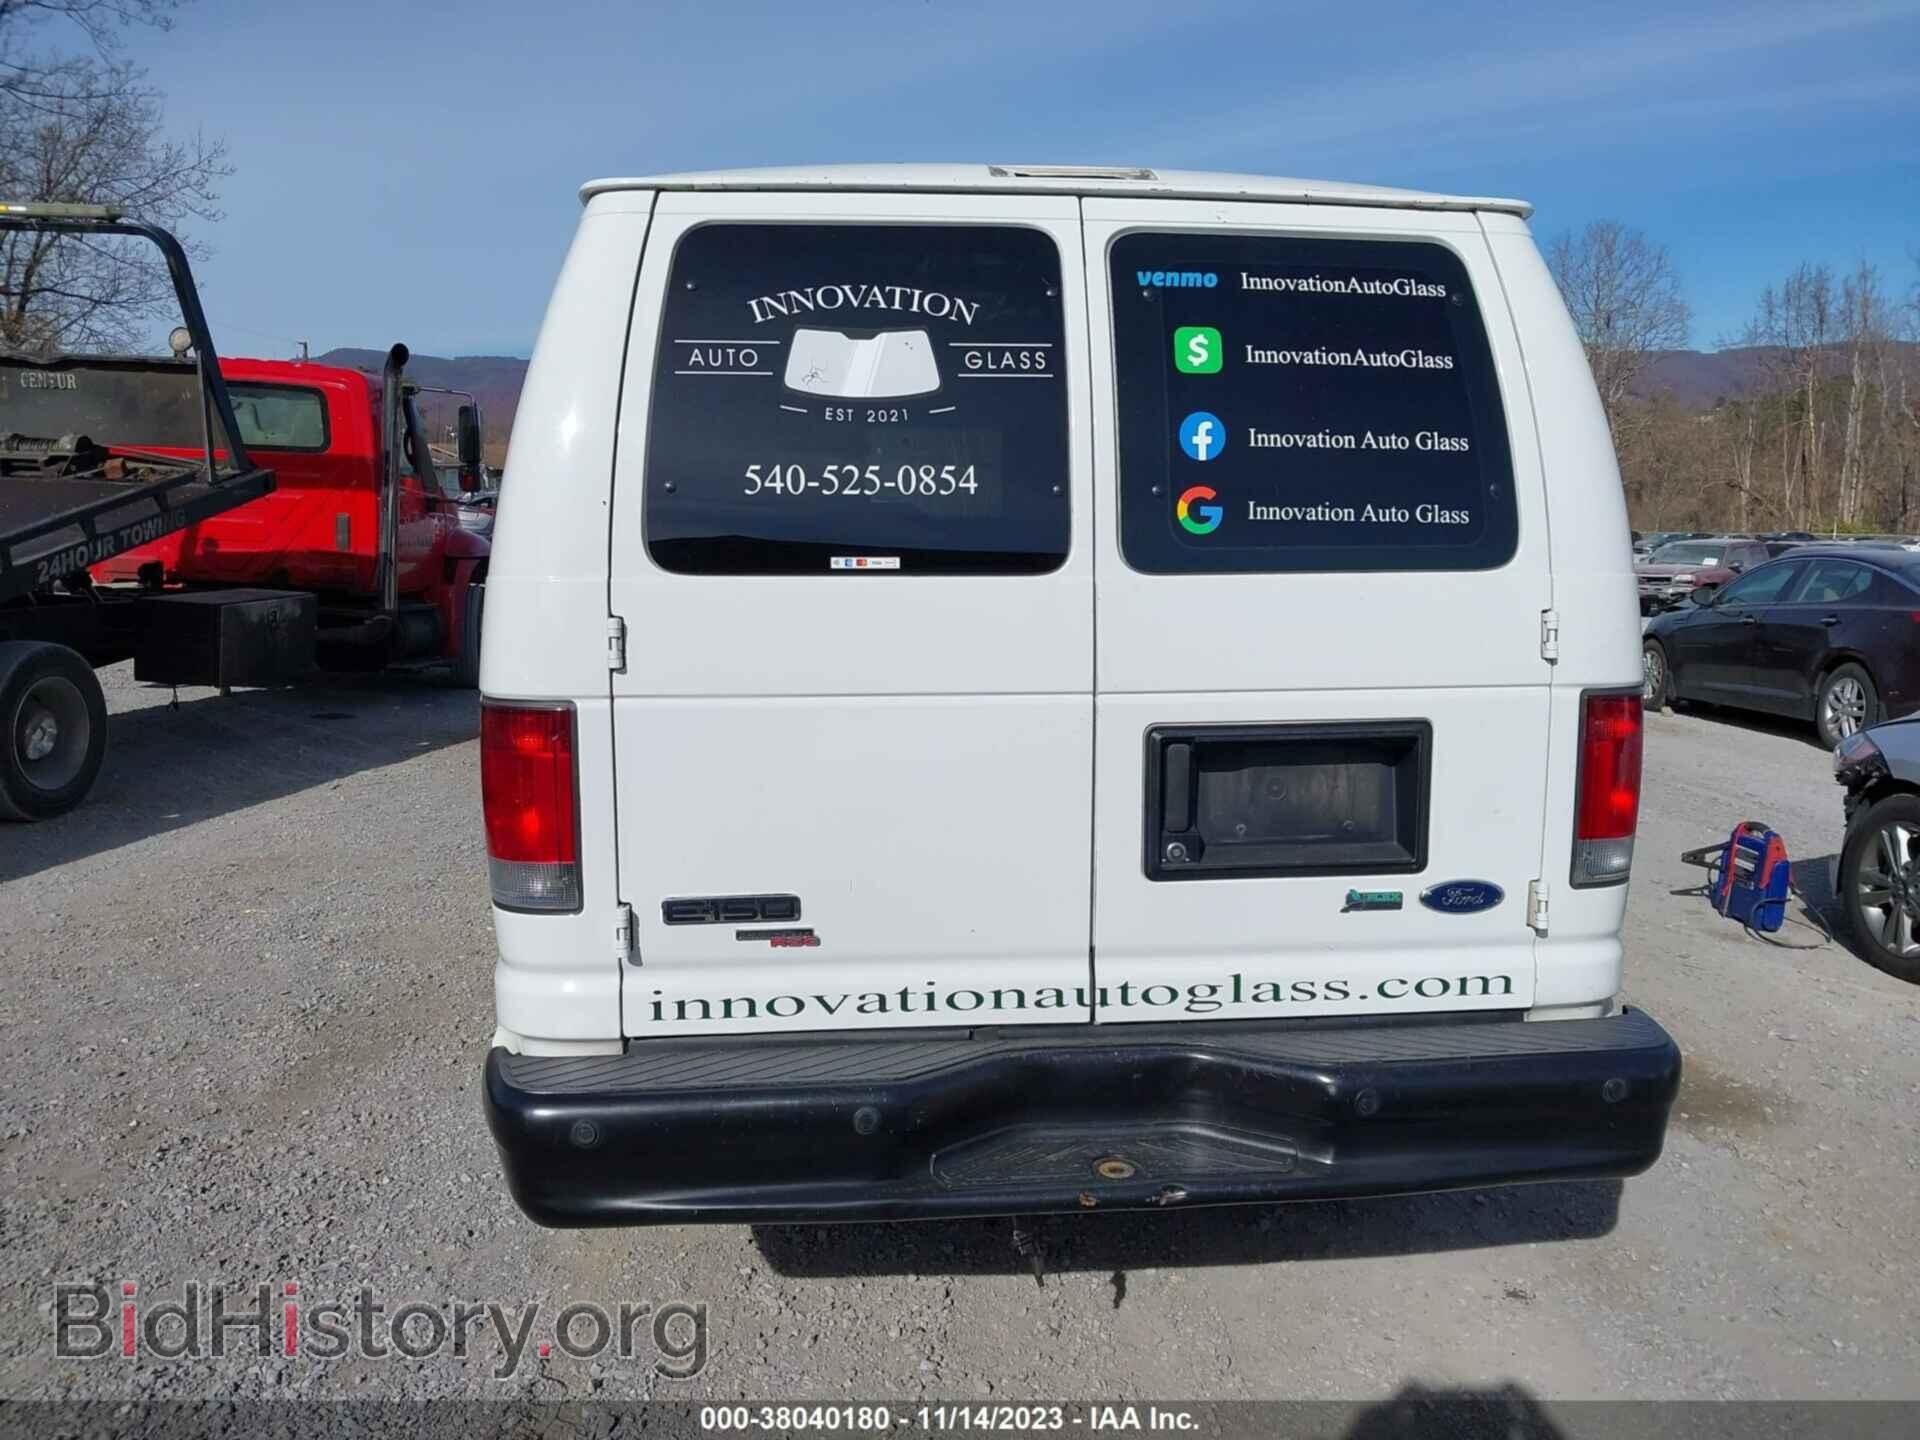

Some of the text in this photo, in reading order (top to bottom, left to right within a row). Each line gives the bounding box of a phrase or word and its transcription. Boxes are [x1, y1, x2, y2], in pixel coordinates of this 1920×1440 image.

[1136, 271, 1447, 298] venmo InnovationAutoGlass
[746, 284, 981, 326] INNOVATION
[688, 348, 1048, 370] AUTO GLASS
[1245, 344, 1455, 370] InnovationAutoGlass
[824, 407, 909, 423] EST 2021
[1248, 427, 1470, 452] Innovation Auto Glass
[743, 463, 979, 496] 540-525-0854
[1247, 500, 1470, 524] Innovation Auto Glass
[1441, 887, 1486, 906] Ford
[650, 972, 1514, 1022] innovationautoglass.com
